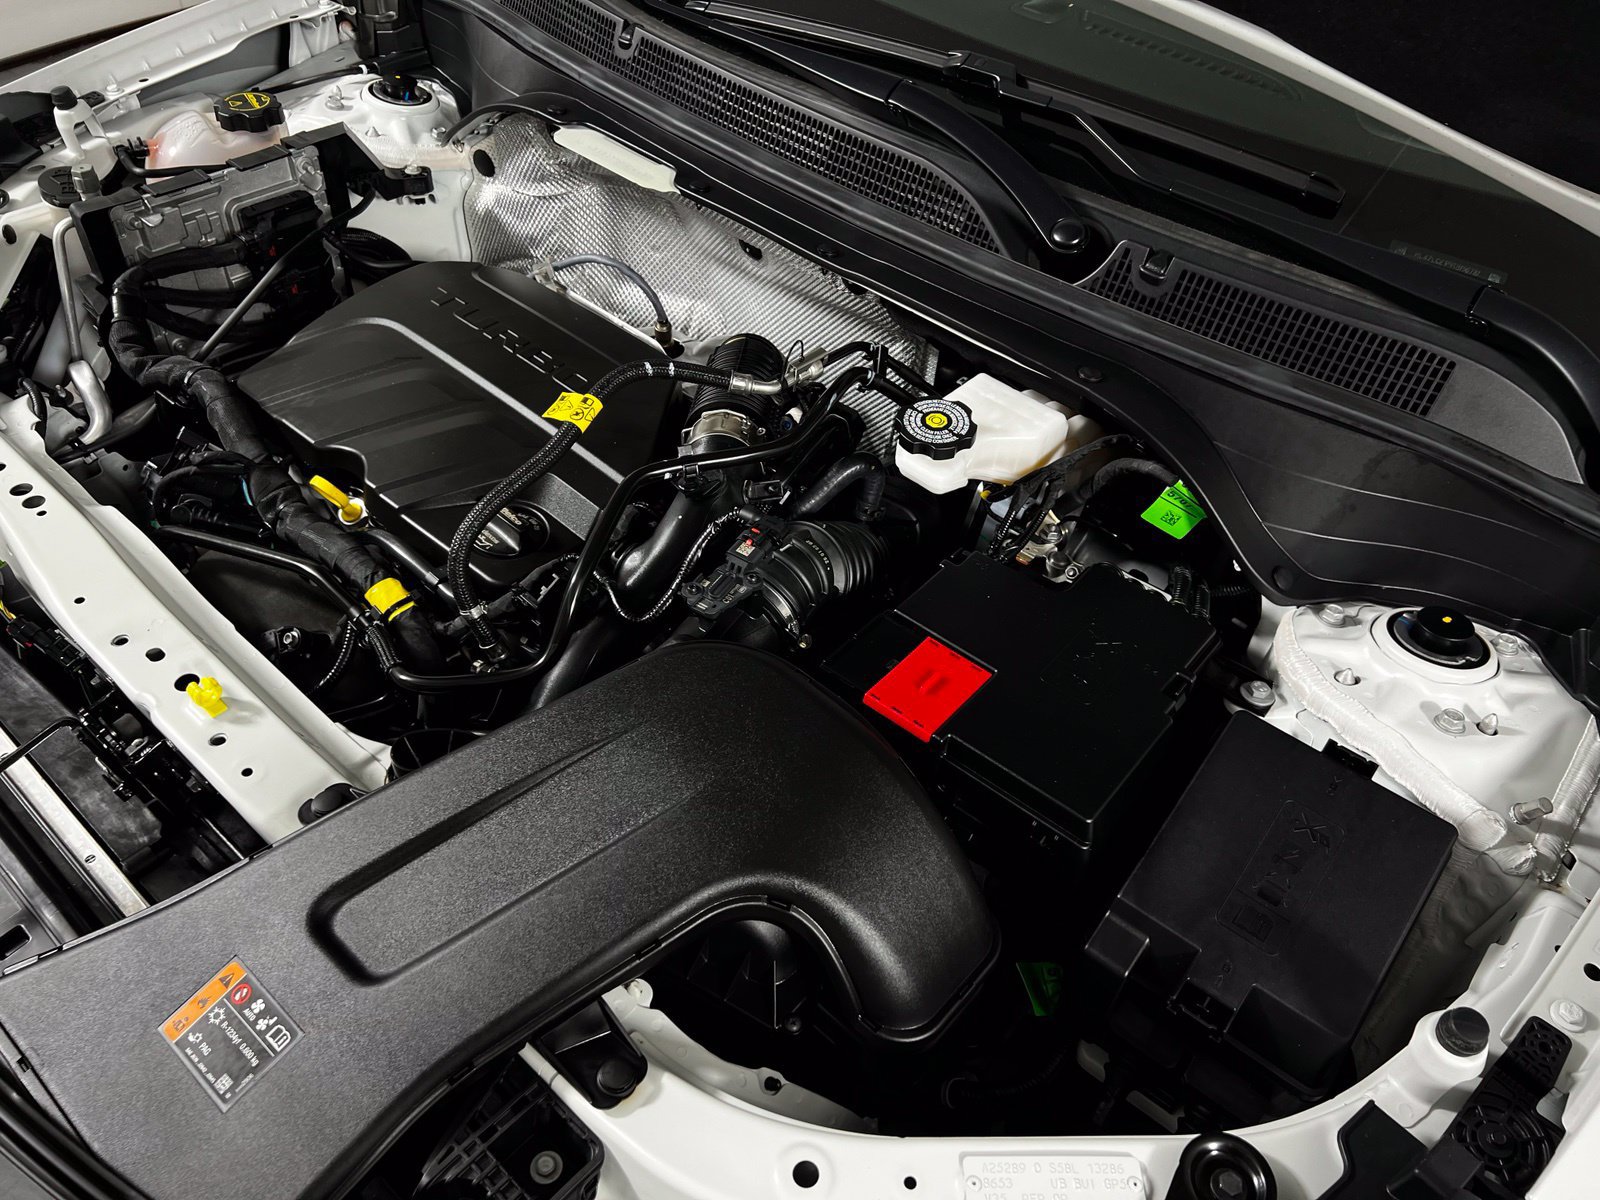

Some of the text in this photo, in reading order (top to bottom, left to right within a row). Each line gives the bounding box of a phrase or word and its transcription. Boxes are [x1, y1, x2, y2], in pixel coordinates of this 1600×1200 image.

[430, 287, 588, 392] TURBO
[242, 1008, 256, 1022] AUTO
[198, 1042, 212, 1056] PAG
[251, 1056, 260, 1067] kg
[982, 1162, 1026, 1174] A25289
[1049, 1162, 1080, 1174] S58L
[1087, 1162, 1125, 1174] 13286
[982, 1177, 1014, 1188] 8653
